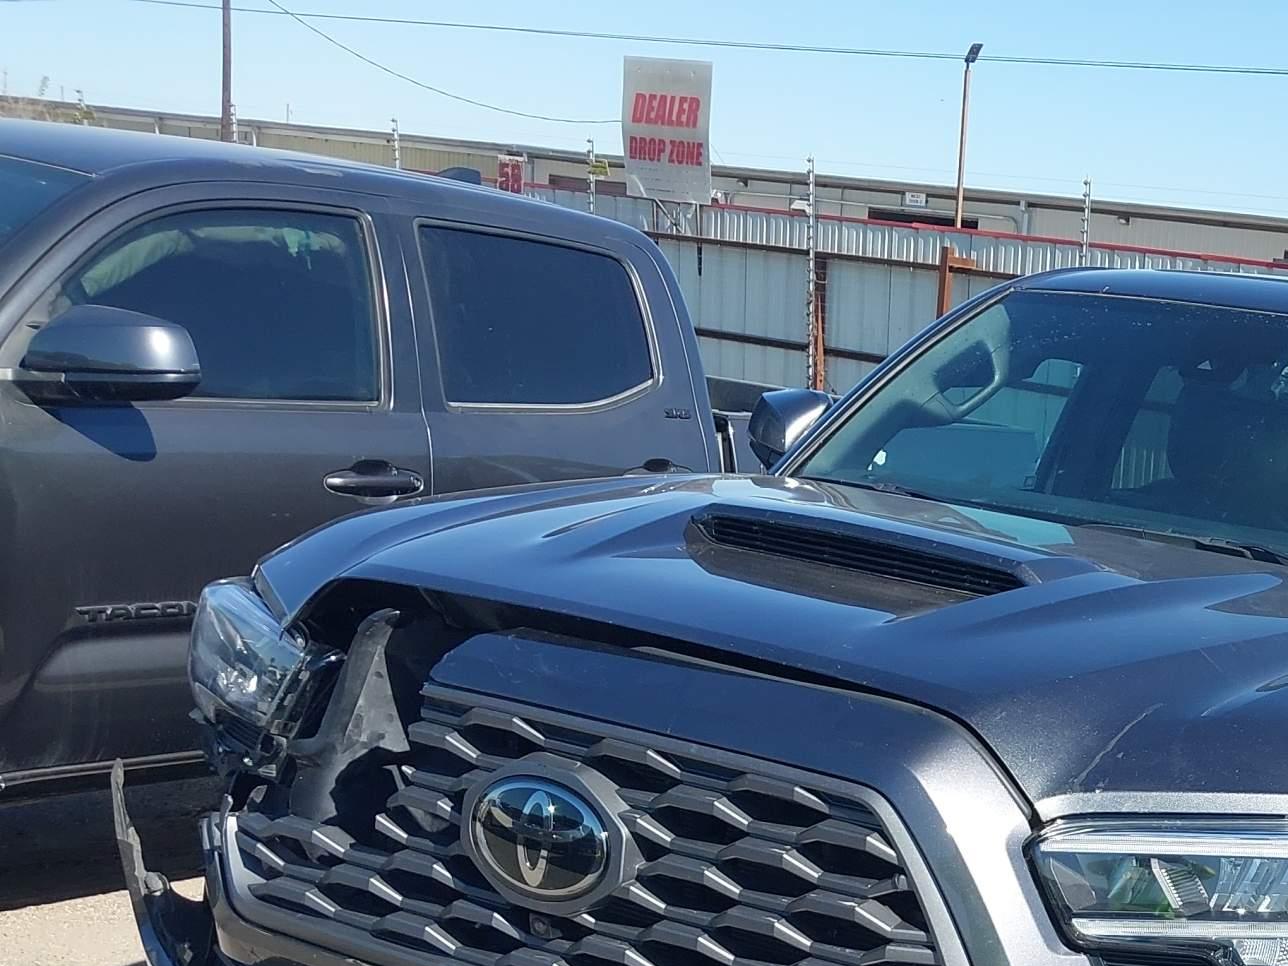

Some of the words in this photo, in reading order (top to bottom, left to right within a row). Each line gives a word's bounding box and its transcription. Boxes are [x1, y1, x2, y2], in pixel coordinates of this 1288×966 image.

[631, 92, 701, 128] DEALER
[629, 135, 666, 163] DROP
[668, 140, 704, 166] ZONE
